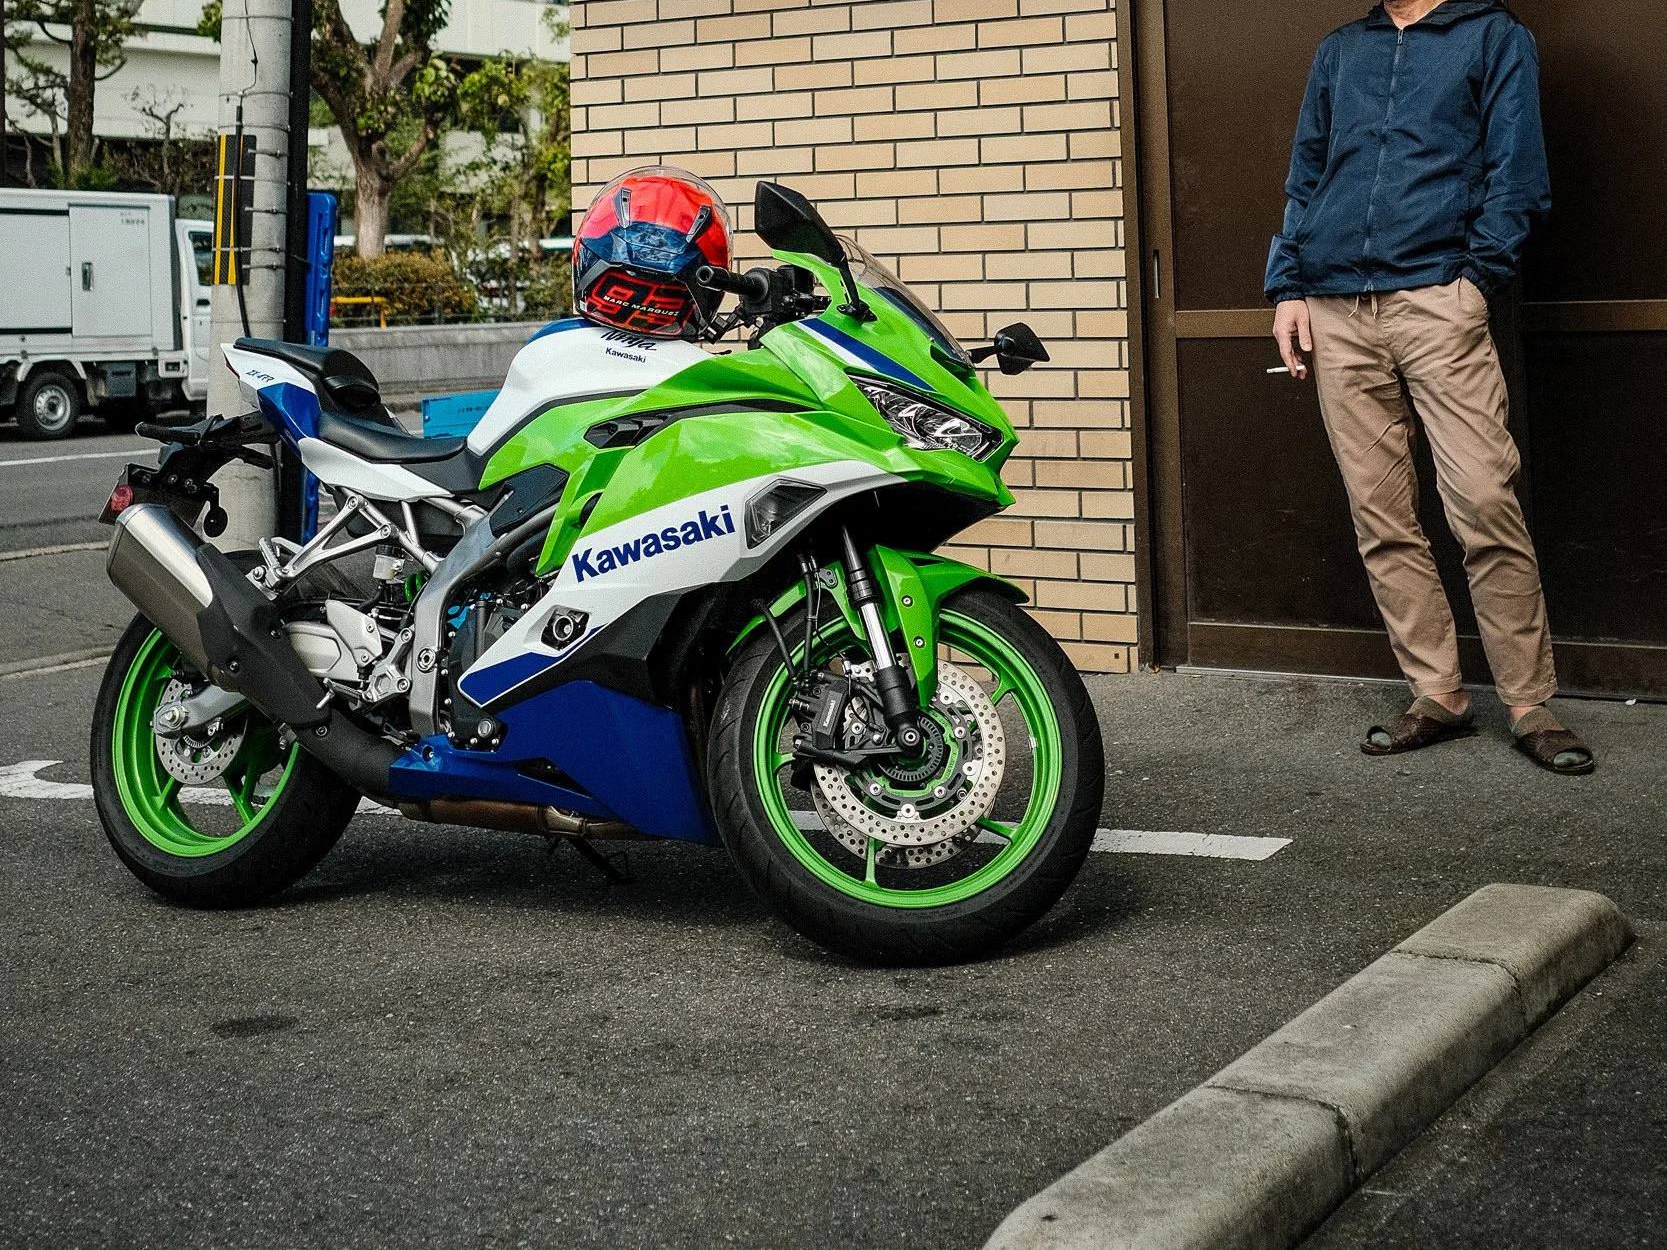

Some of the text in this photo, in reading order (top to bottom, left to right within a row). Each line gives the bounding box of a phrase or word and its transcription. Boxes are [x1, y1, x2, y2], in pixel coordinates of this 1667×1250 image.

[602, 295, 630, 307] MARC
[605, 347, 647, 364] Kawasaki
[571, 504, 736, 583] Kawasaki
